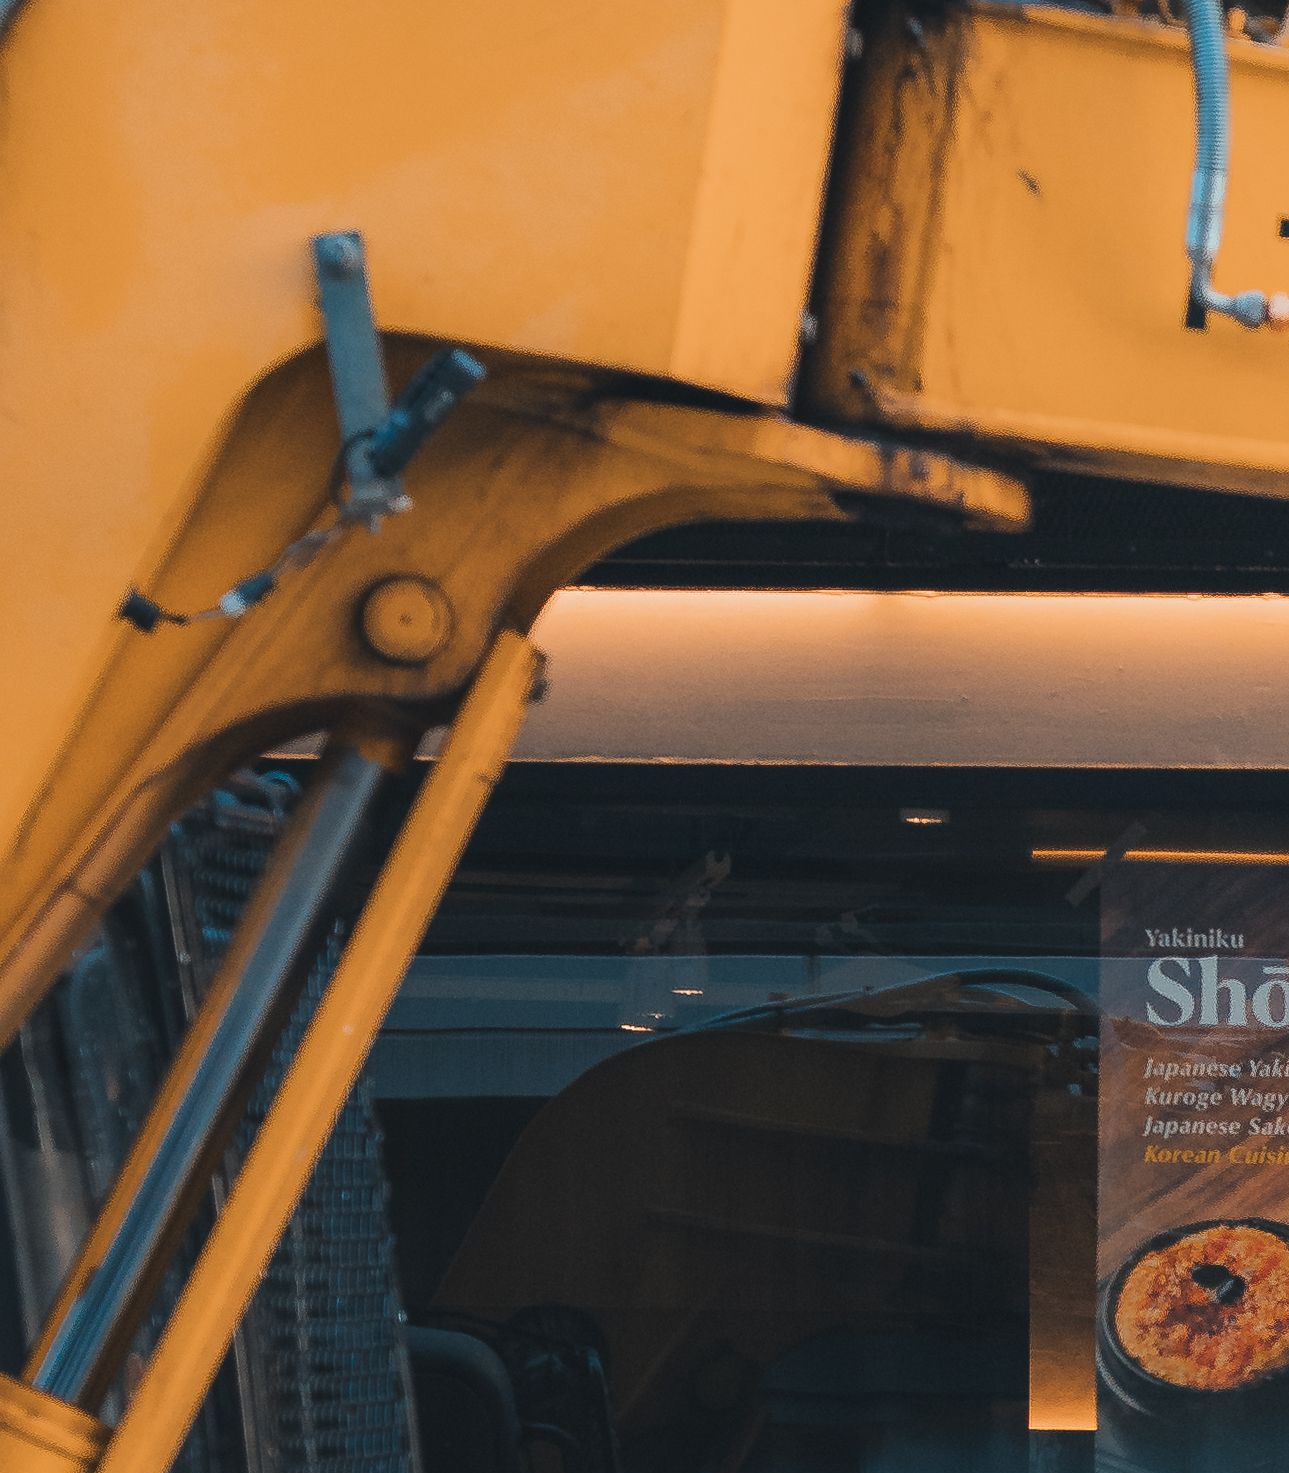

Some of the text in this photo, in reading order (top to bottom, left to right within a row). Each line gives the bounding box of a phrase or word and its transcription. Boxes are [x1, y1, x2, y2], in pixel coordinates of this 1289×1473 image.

[1145, 927, 1244, 948] Yakiniku
[1143, 1056, 1242, 1082] Japanese
[1144, 1086, 1223, 1111] Kuroge
[1143, 1115, 1242, 1139] Japanese
[1144, 1144, 1221, 1165] Korean
